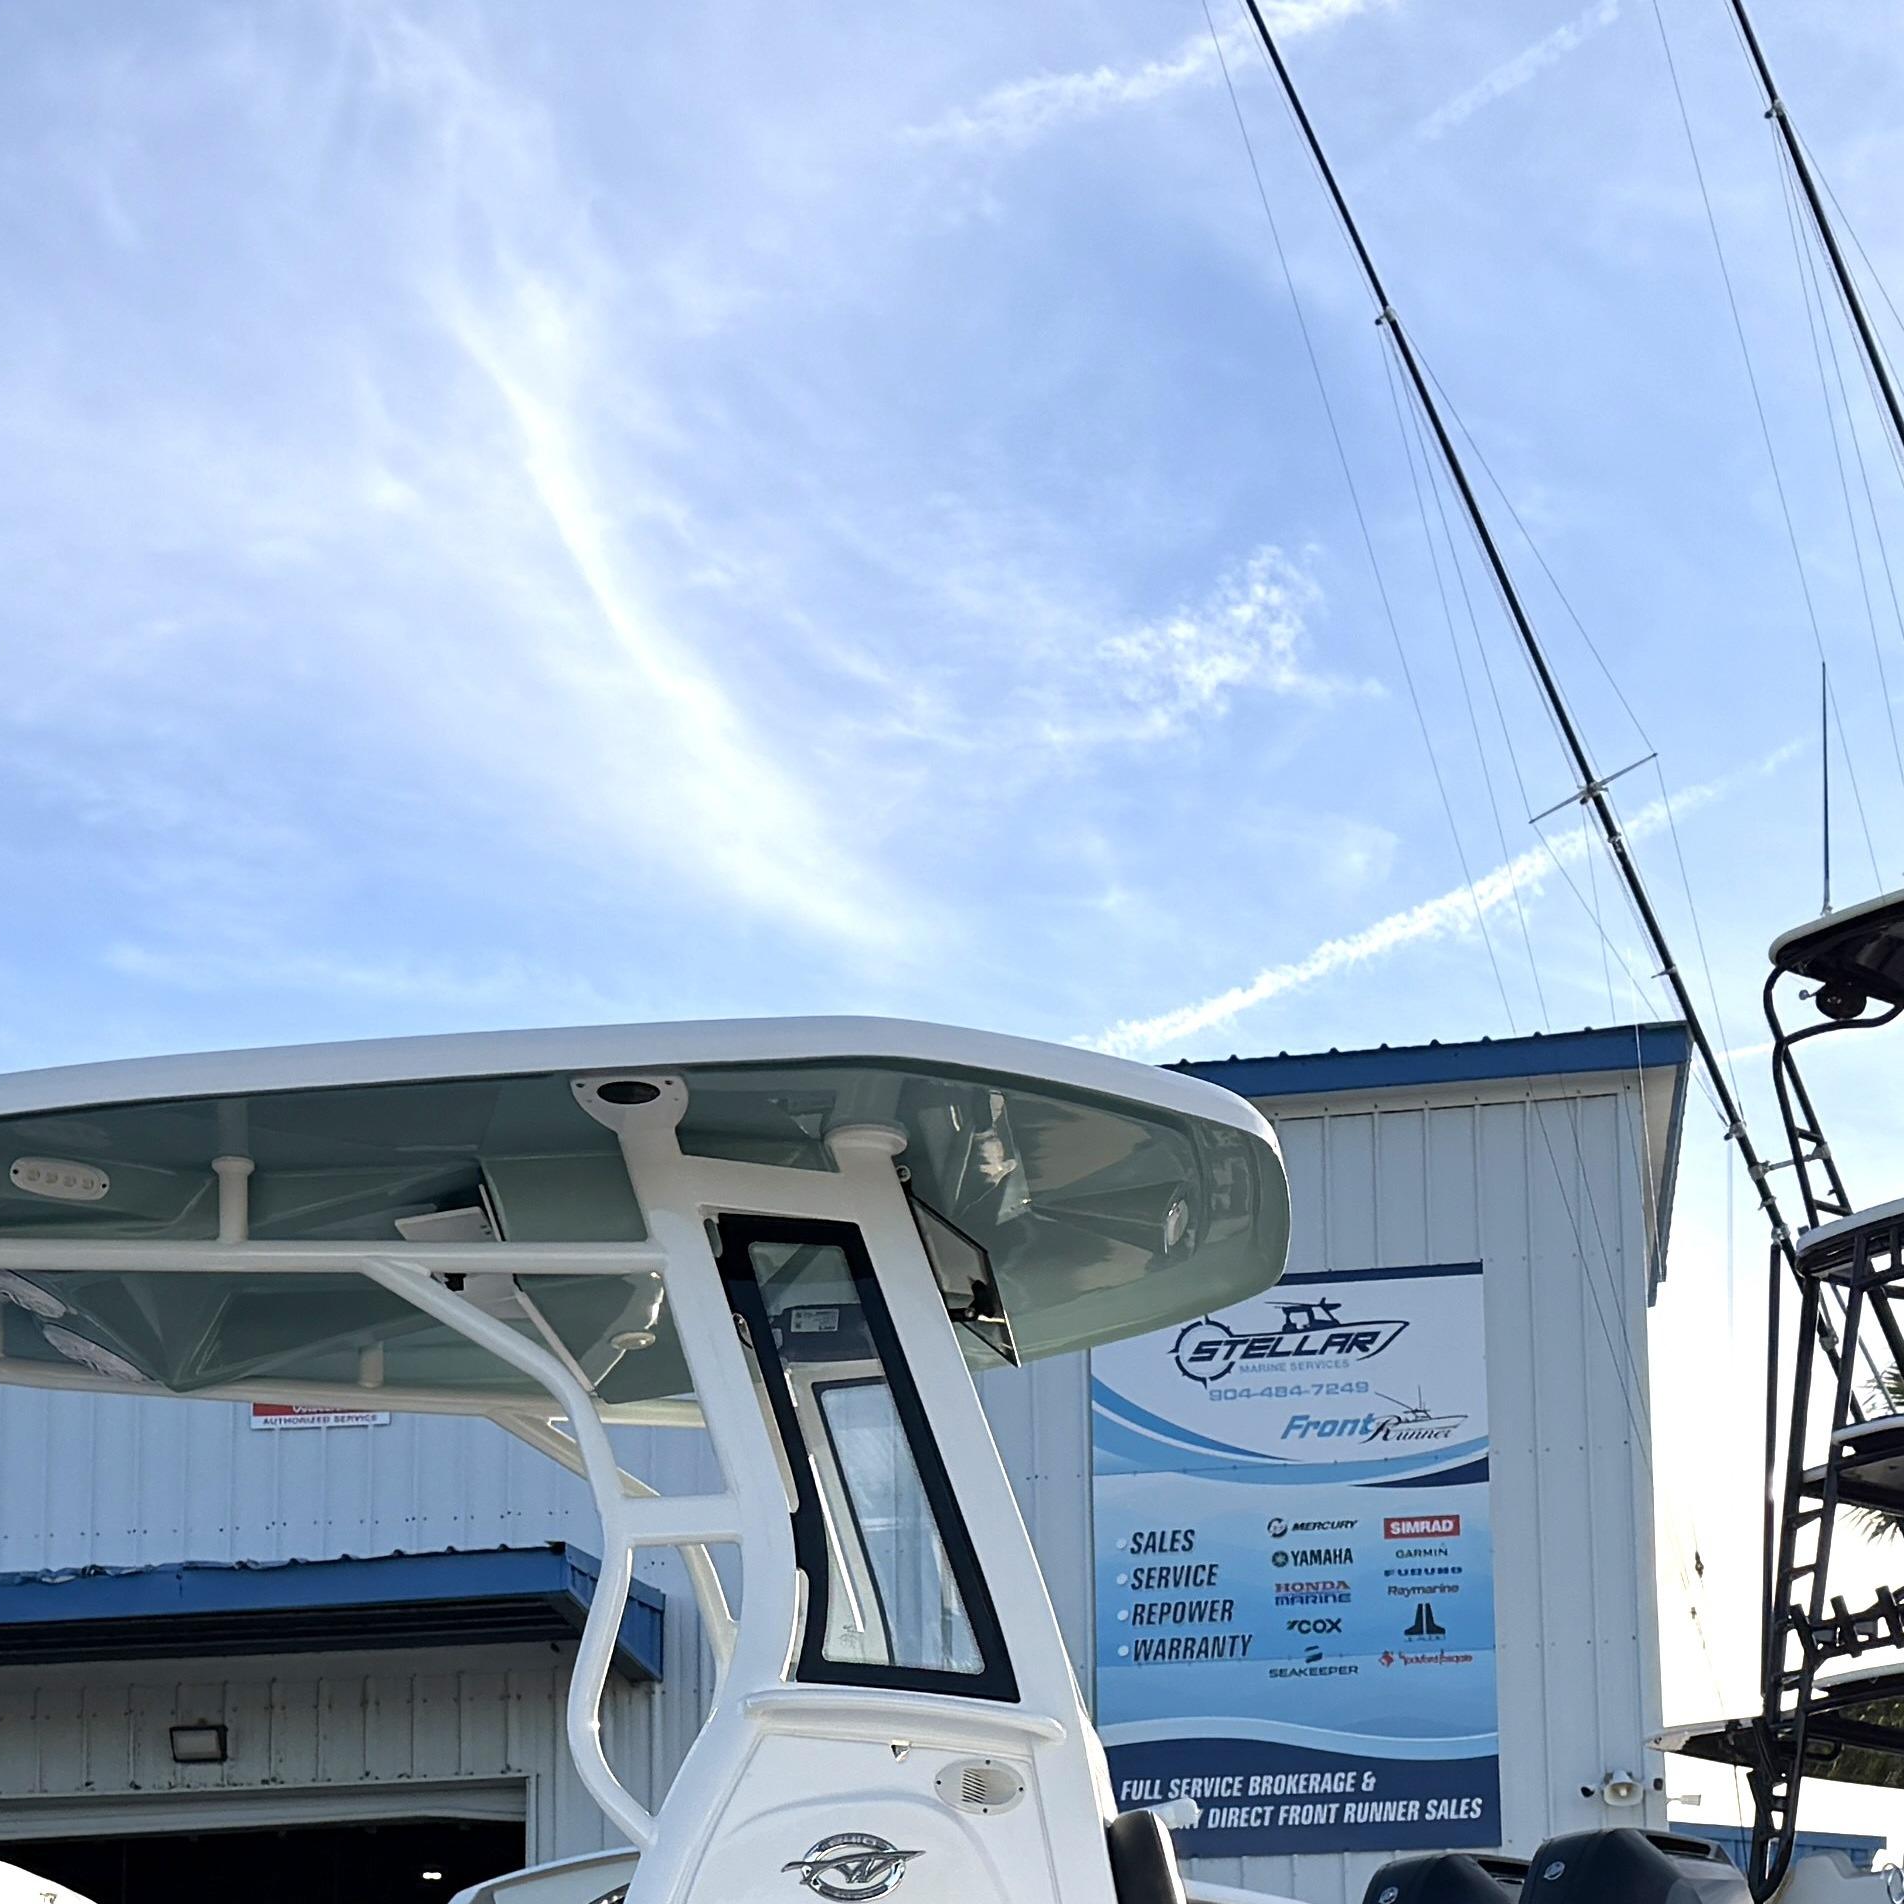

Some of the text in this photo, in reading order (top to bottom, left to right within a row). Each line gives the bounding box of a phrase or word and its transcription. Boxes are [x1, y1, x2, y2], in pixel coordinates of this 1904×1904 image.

[1187, 1331, 1381, 1362] STELLAR
[1239, 1359, 1350, 1374] MARINE SERVICES
[1209, 1381, 1370, 1401] 904-484-7249
[263, 1413, 378, 1426] AUTHORIZED SERVICE
[1292, 1519, 1359, 1531] MERCURY
[1390, 1519, 1454, 1535] SIMRAD
[1130, 1529, 1195, 1554] SALES
[1290, 1548, 1353, 1567] YAMAHA
[1395, 1547, 1448, 1559] GARMIN
[1131, 1563, 1219, 1590] SERVICE
[1275, 1580, 1351, 1593] HONDA
[1387, 1584, 1460, 1598] Raymarine
[1132, 1599, 1234, 1626] REPOWER
[1297, 1618, 1343, 1634] COX
[1133, 1634, 1253, 1662] WARRANTY
[1269, 1666, 1359, 1679] SEAKEEPER
[1120, 1771, 1377, 1801] FULL SERVICE BROKERAGE &
[1207, 1806, 1274, 1829] DIRECT
[1278, 1803, 1340, 1826] FRONT
[1343, 1800, 1421, 1824] RUNNER
[1425, 1797, 1483, 1821] SALES
